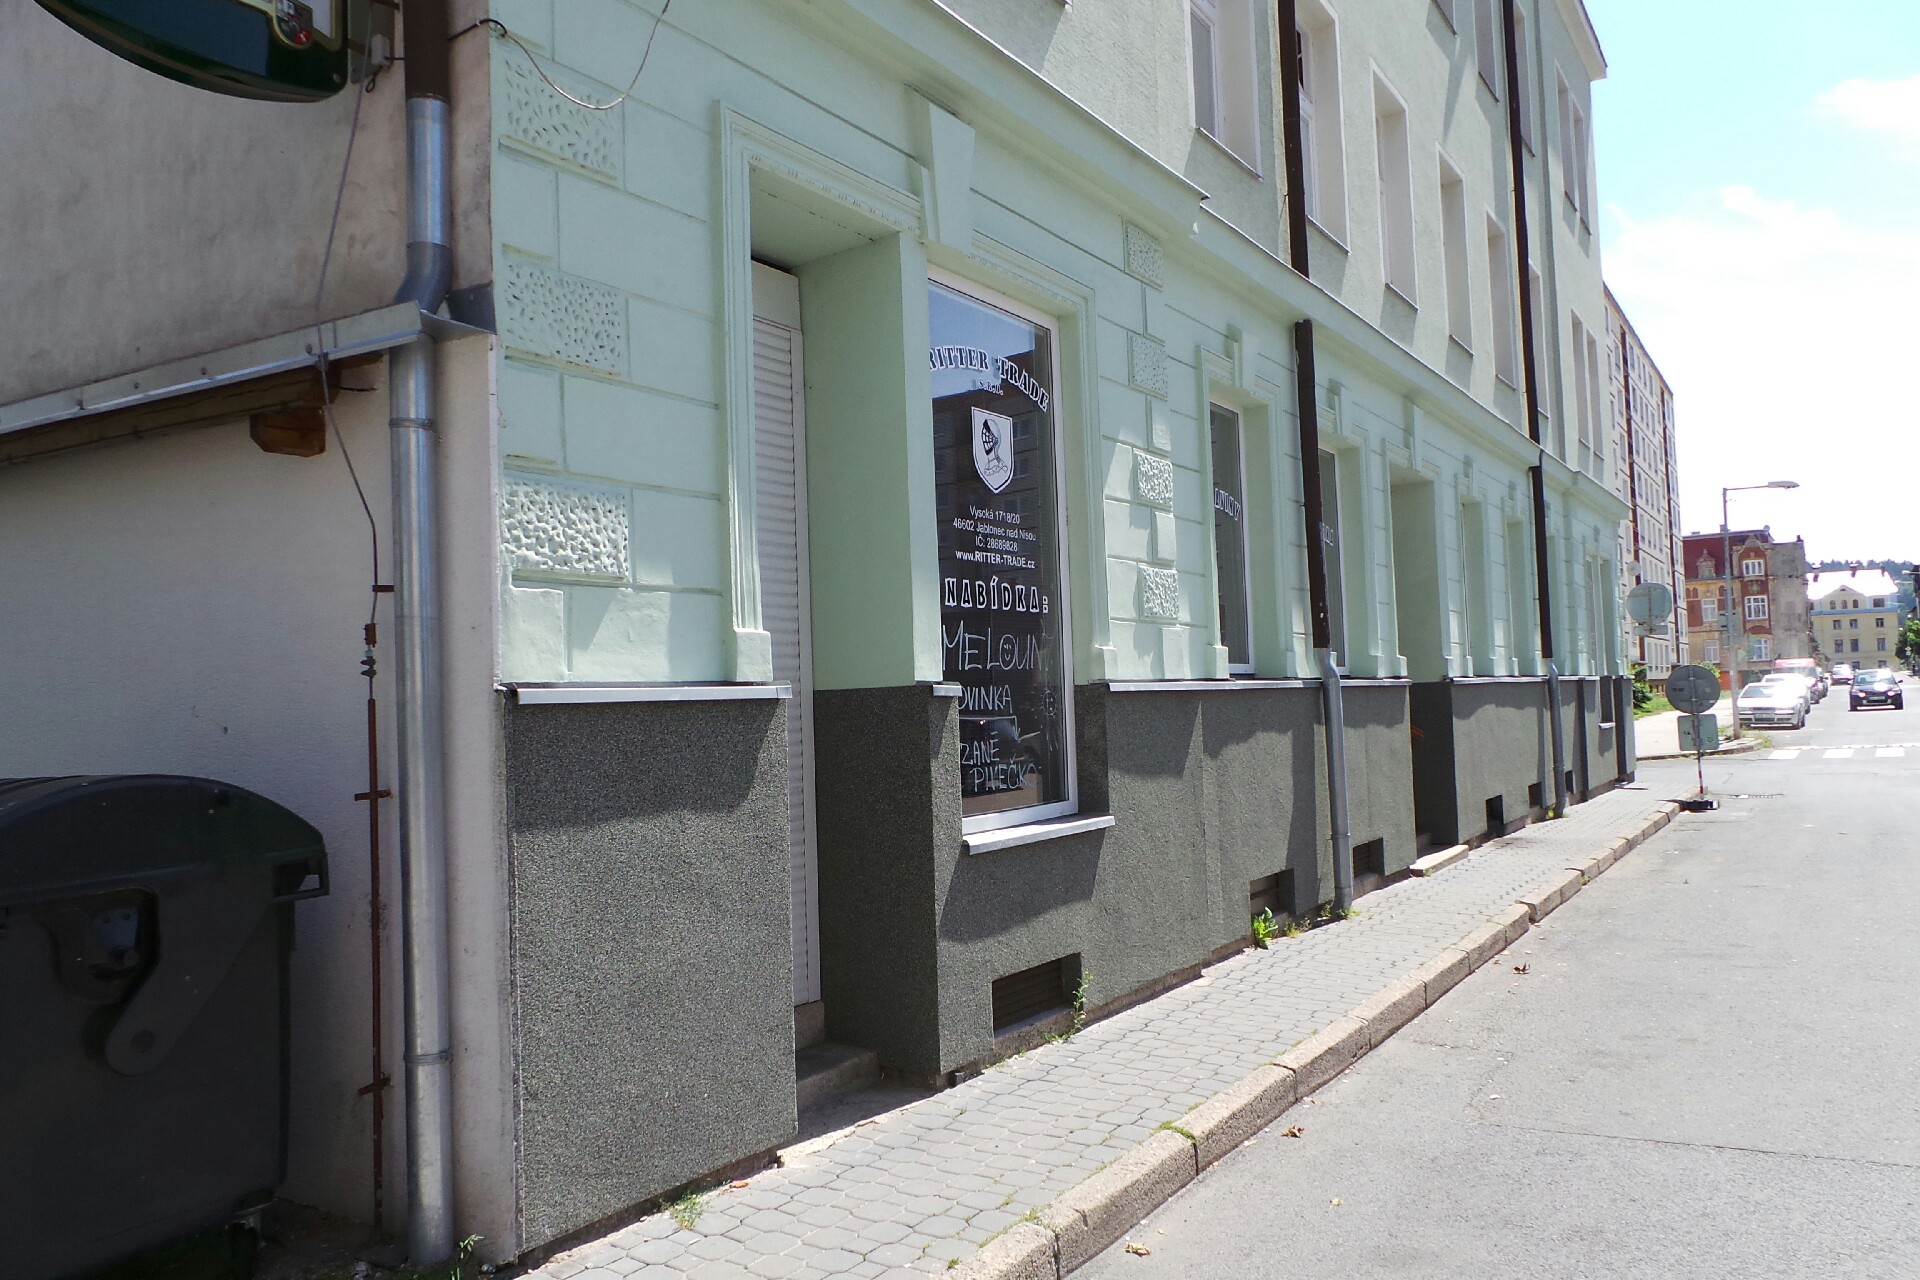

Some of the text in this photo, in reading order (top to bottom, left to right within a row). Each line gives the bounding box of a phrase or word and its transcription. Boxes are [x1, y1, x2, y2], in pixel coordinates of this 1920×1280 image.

[929, 345, 1049, 413] RITTER TRADE
[969, 505, 1020, 525] Vysoká 1718/20
[953, 517, 1037, 541] 46602 Jablonec nad Nisou
[975, 534, 986, 548] IČ:
[955, 550, 1036, 569] www.RITTER-TRADE.cz
[945, 575, 1049, 614] NABÍDKA:
[942, 620, 1041, 671] MELOUN
